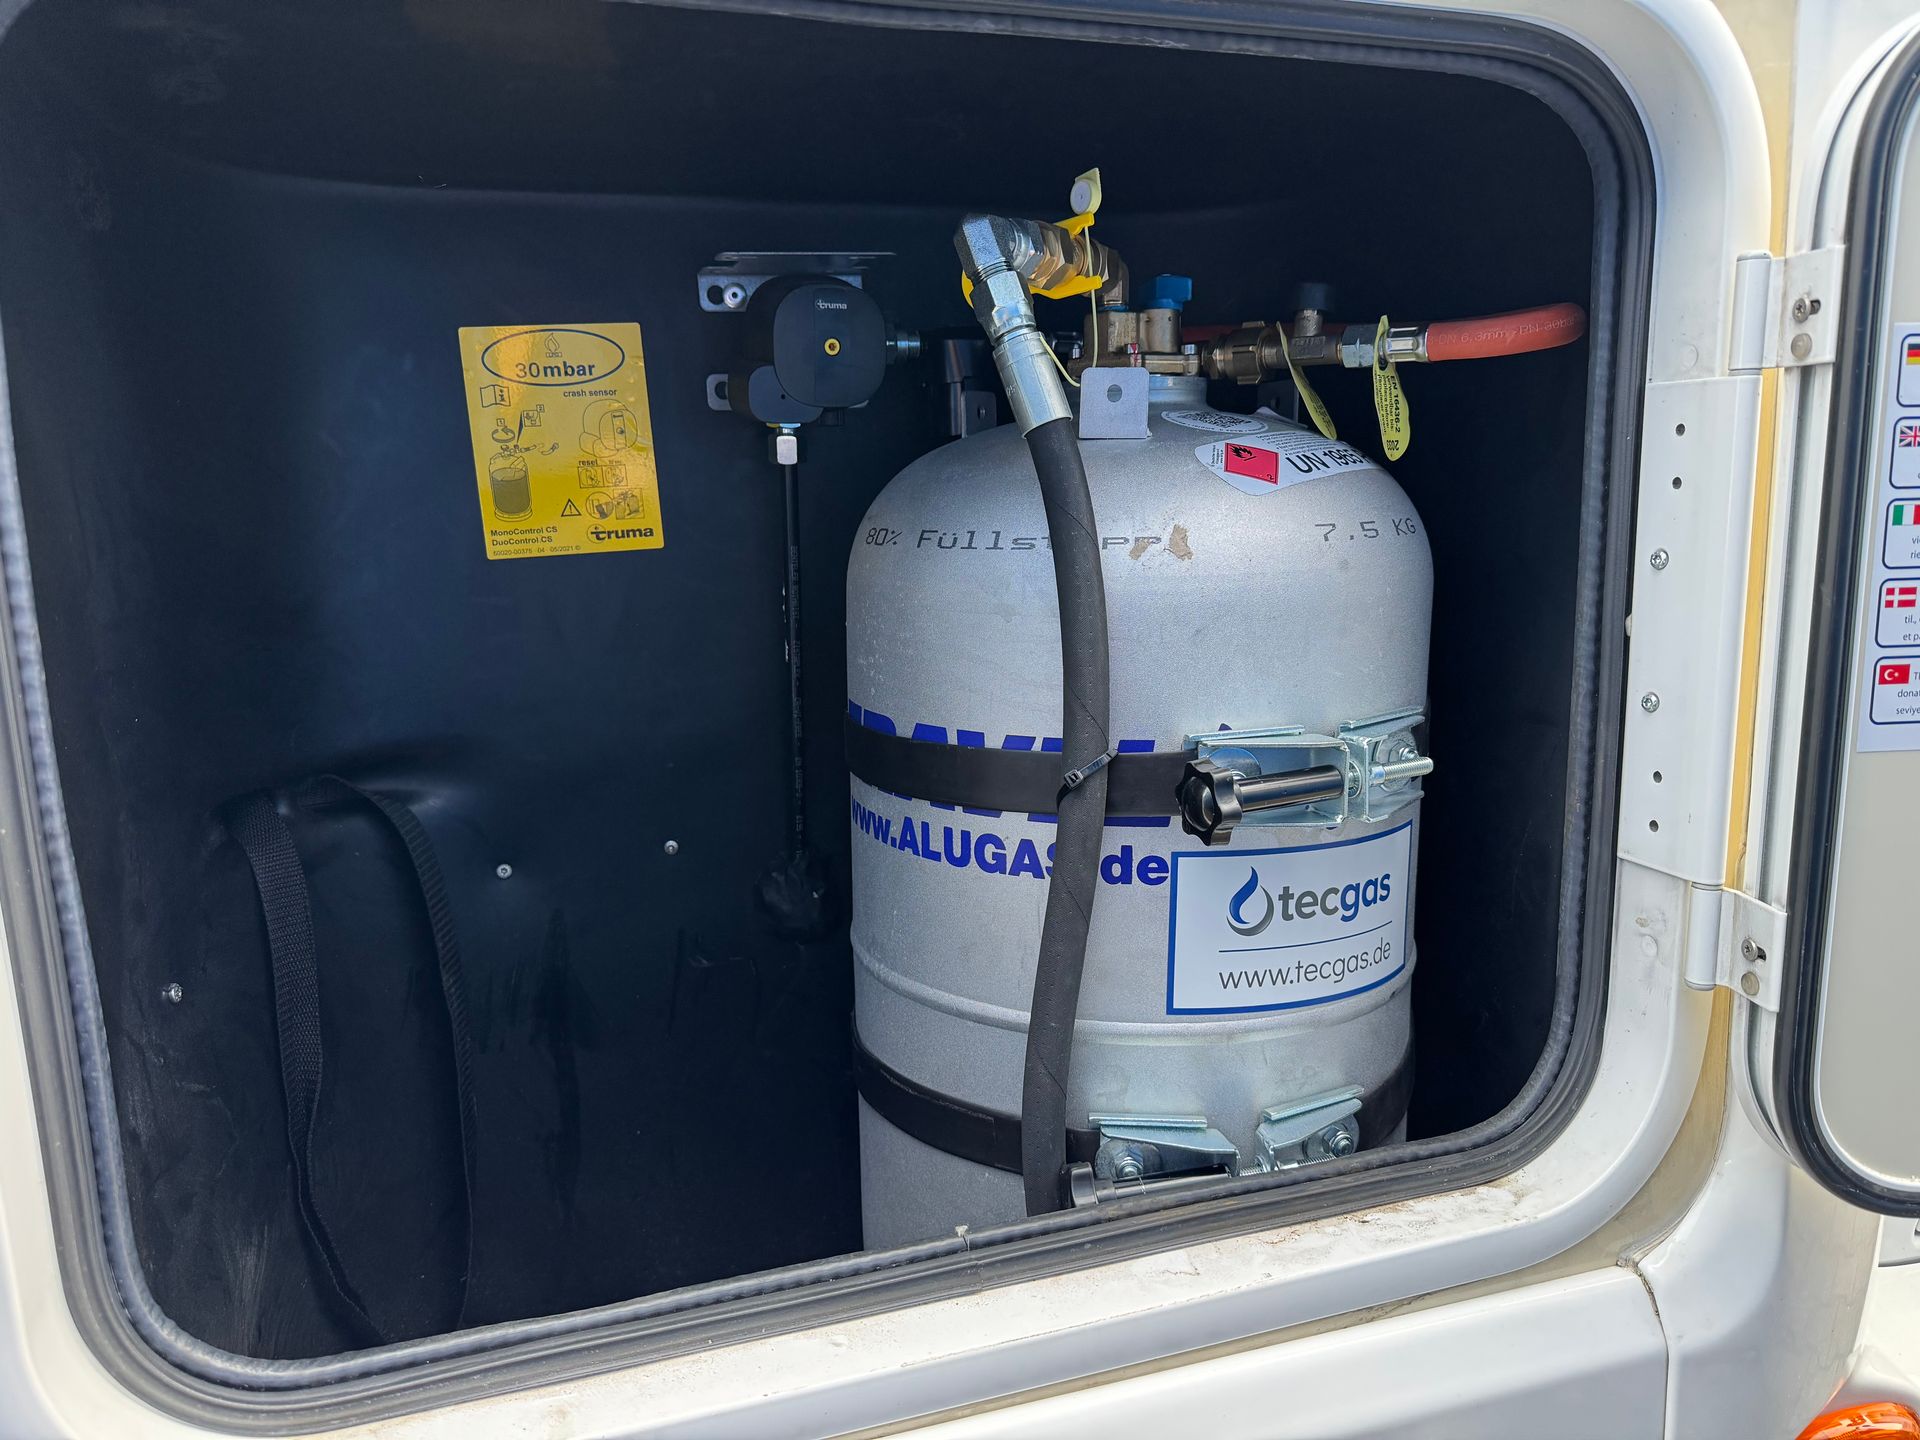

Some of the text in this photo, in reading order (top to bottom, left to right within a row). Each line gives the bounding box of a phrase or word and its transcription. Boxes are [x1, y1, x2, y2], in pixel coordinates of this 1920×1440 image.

[816, 299, 847, 311] truma
[515, 361, 596, 379] 30mbar
[1390, 376, 1398, 390] EN
[563, 388, 617, 398] crash sensor
[1285, 452, 1330, 474] UN
[491, 526, 558, 537] MonoControl CS
[591, 525, 654, 541] truma
[865, 527, 903, 546] 80%
[1314, 518, 1417, 543] 7.5 KG
[492, 536, 553, 547] DuoControl CS
[1902, 632, 1911, 641] et
[1278, 873, 1391, 923] tecgas
[1218, 937, 1392, 990] www.tecgas.de
